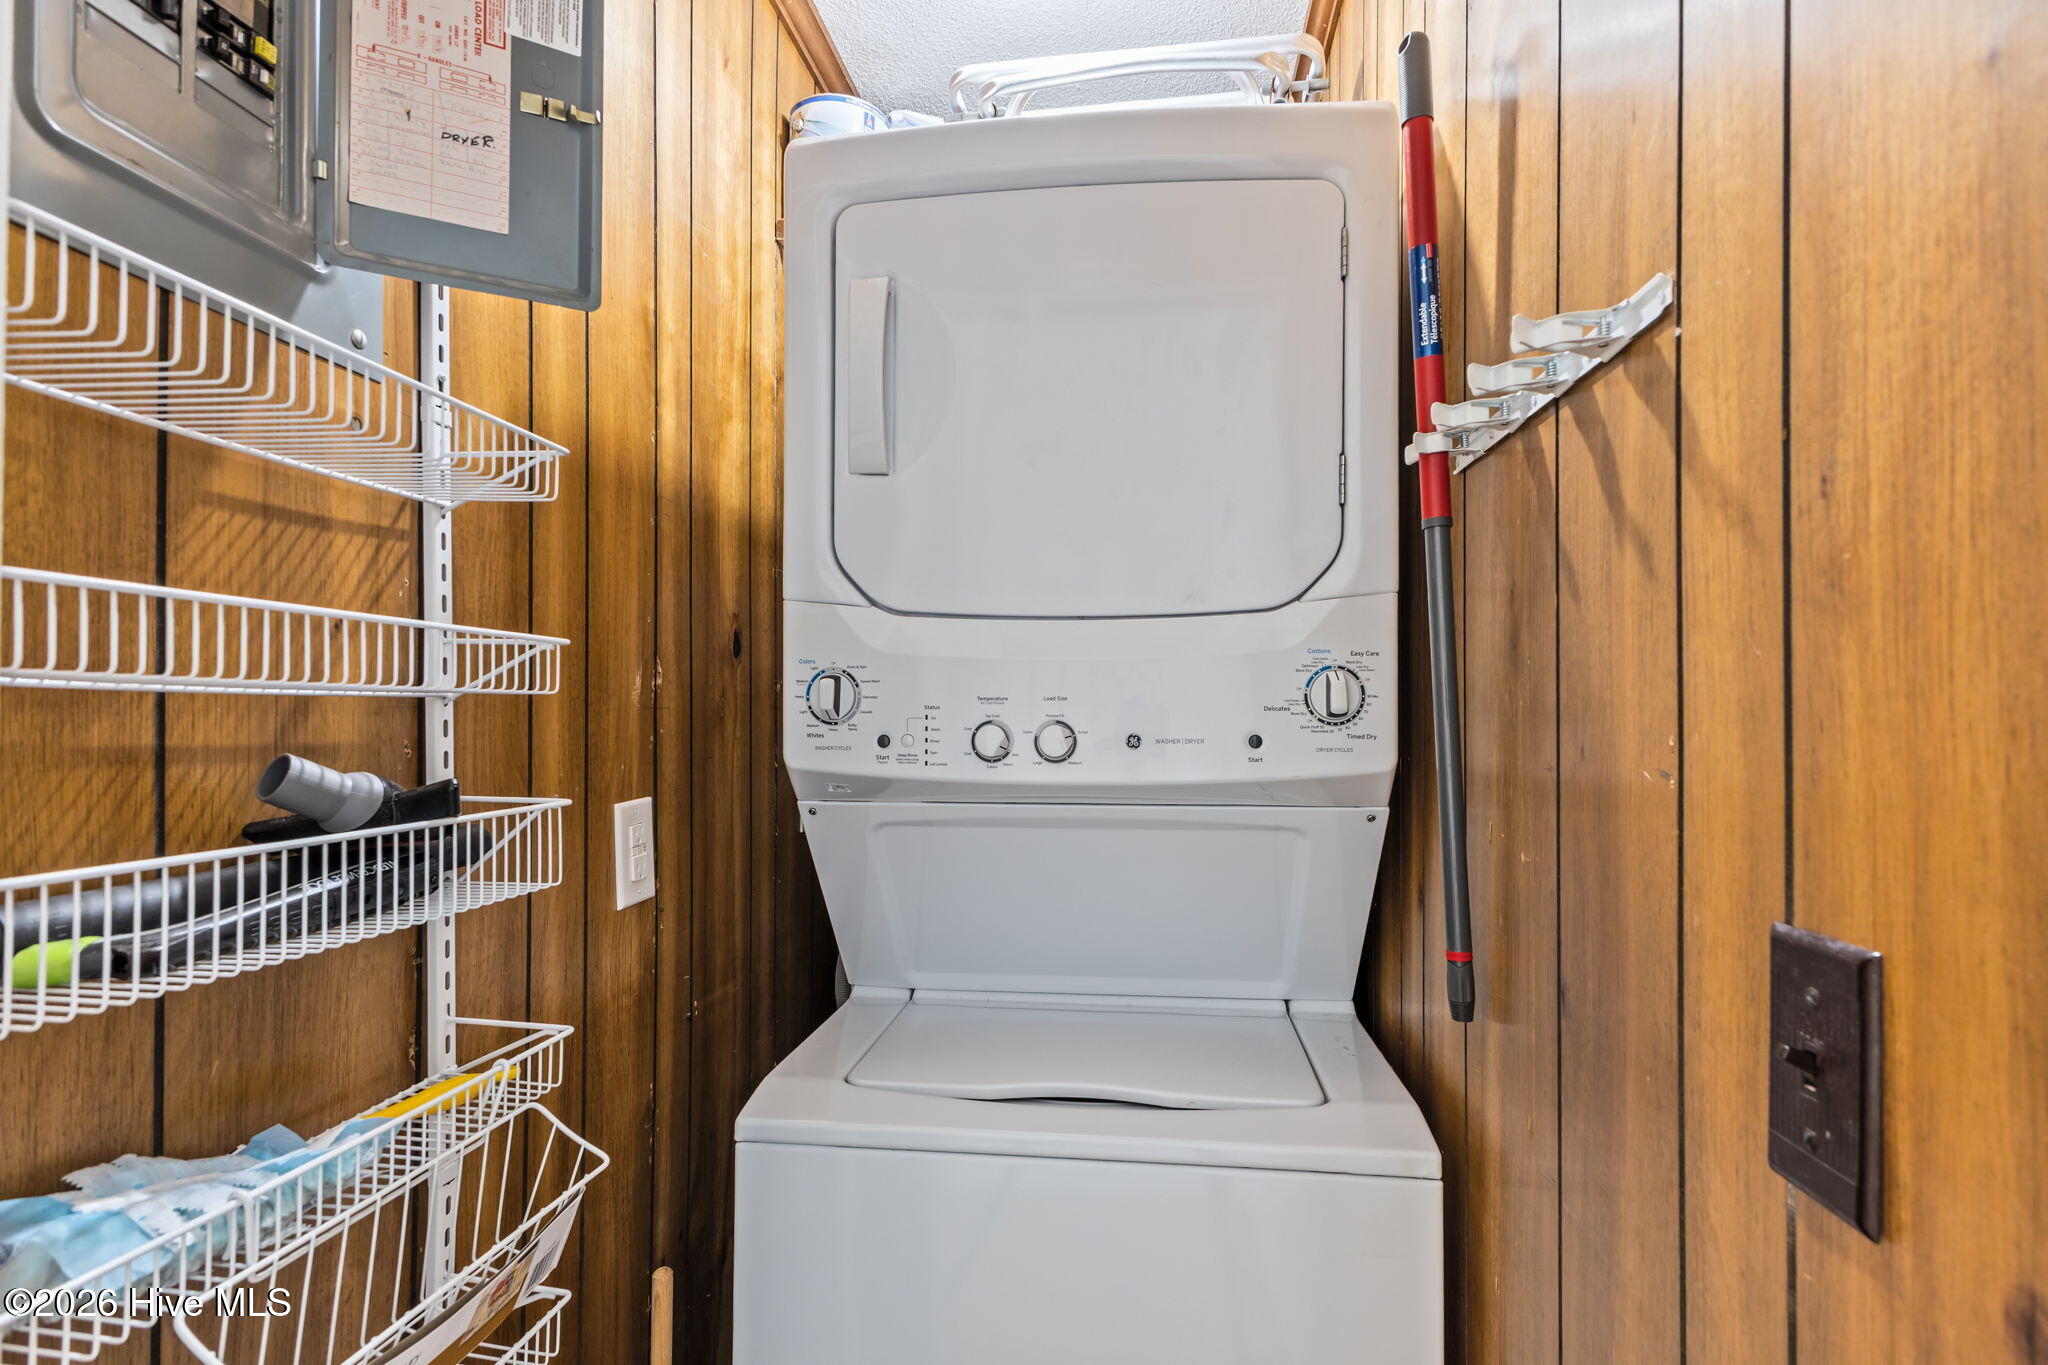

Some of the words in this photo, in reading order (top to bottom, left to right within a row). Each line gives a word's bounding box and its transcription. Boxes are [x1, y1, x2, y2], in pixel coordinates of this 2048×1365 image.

[474, 1, 482, 25] LOAD
[474, 27, 482, 57] CENTER
[1419, 302, 1428, 346] Extendable
[1429, 294, 1438, 344] Télescopique
